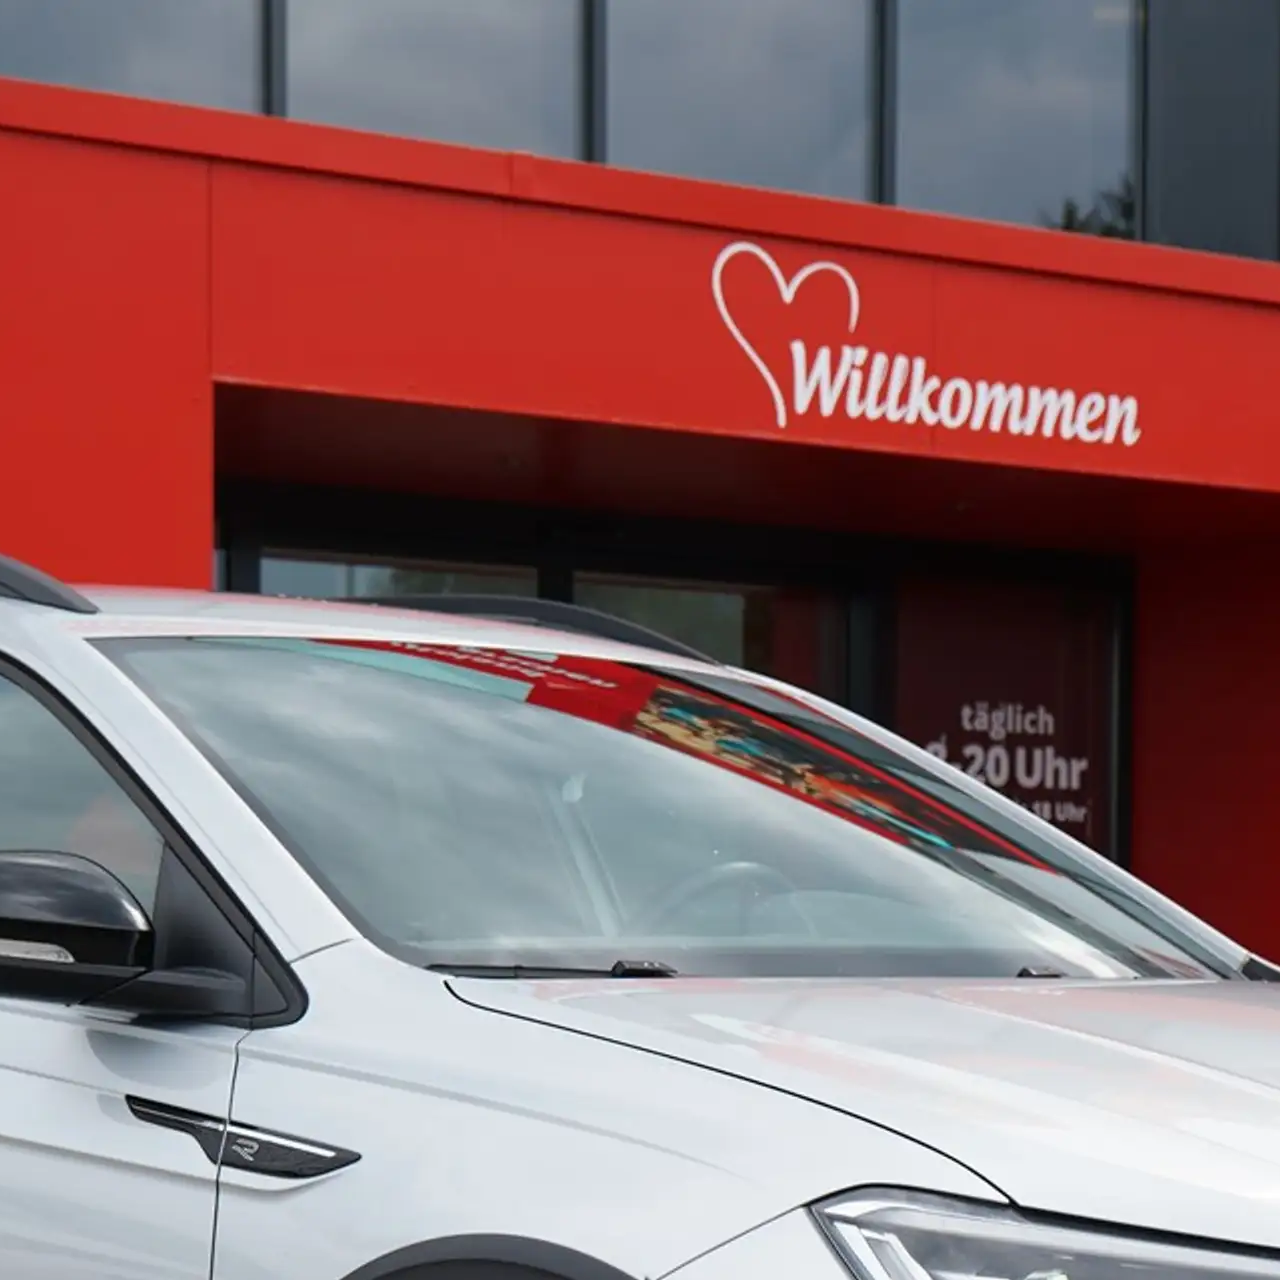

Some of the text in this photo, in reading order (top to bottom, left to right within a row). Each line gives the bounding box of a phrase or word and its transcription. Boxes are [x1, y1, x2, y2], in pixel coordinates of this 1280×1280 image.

[790, 340, 1141, 446] Willkommen
[961, 700, 1054, 740] täglich
[1015, 745, 1088, 790] Uhr
[1055, 801, 1087, 822] Uhr
